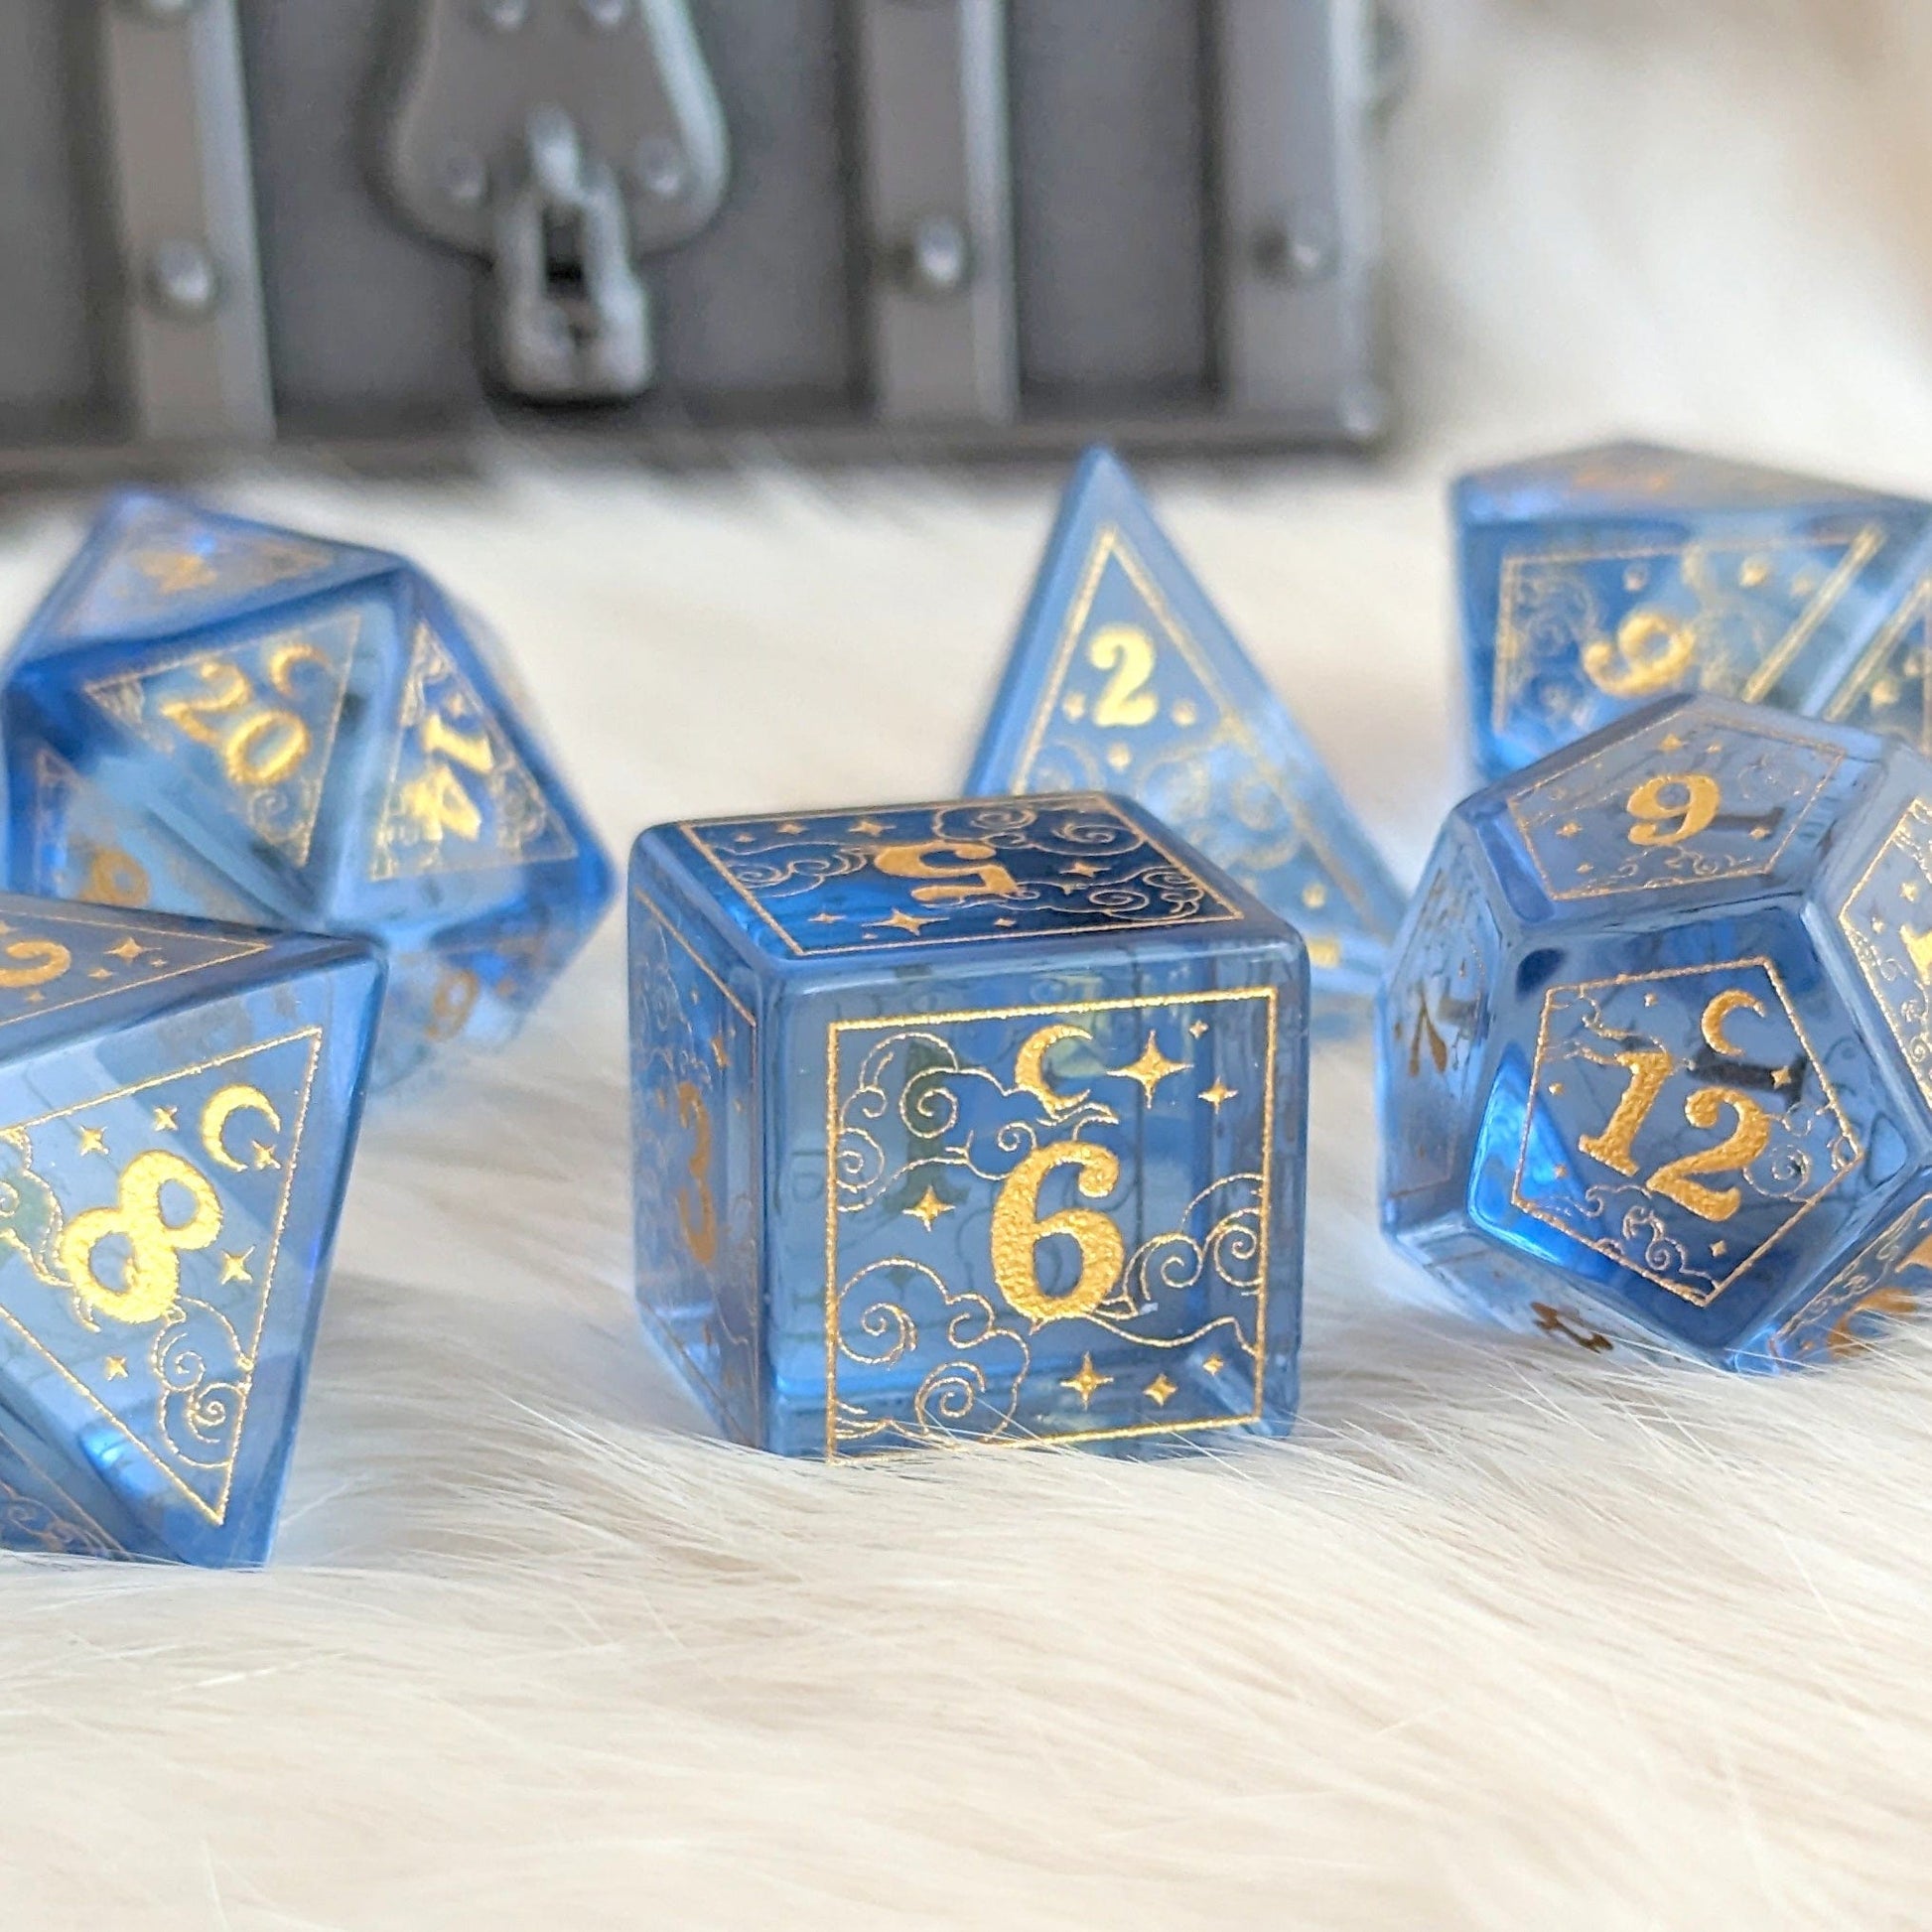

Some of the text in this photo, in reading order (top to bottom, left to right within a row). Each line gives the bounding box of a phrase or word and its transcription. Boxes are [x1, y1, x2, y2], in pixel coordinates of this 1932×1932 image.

[161, 660, 310, 785] 20
[1091, 625, 1158, 726] 2
[874, 840, 1017, 902] 5
[1625, 771, 1721, 846] 9
[1579, 1050, 1770, 1221] 12
[61, 1149, 223, 1323] 8
[991, 1141, 1125, 1320] 6
